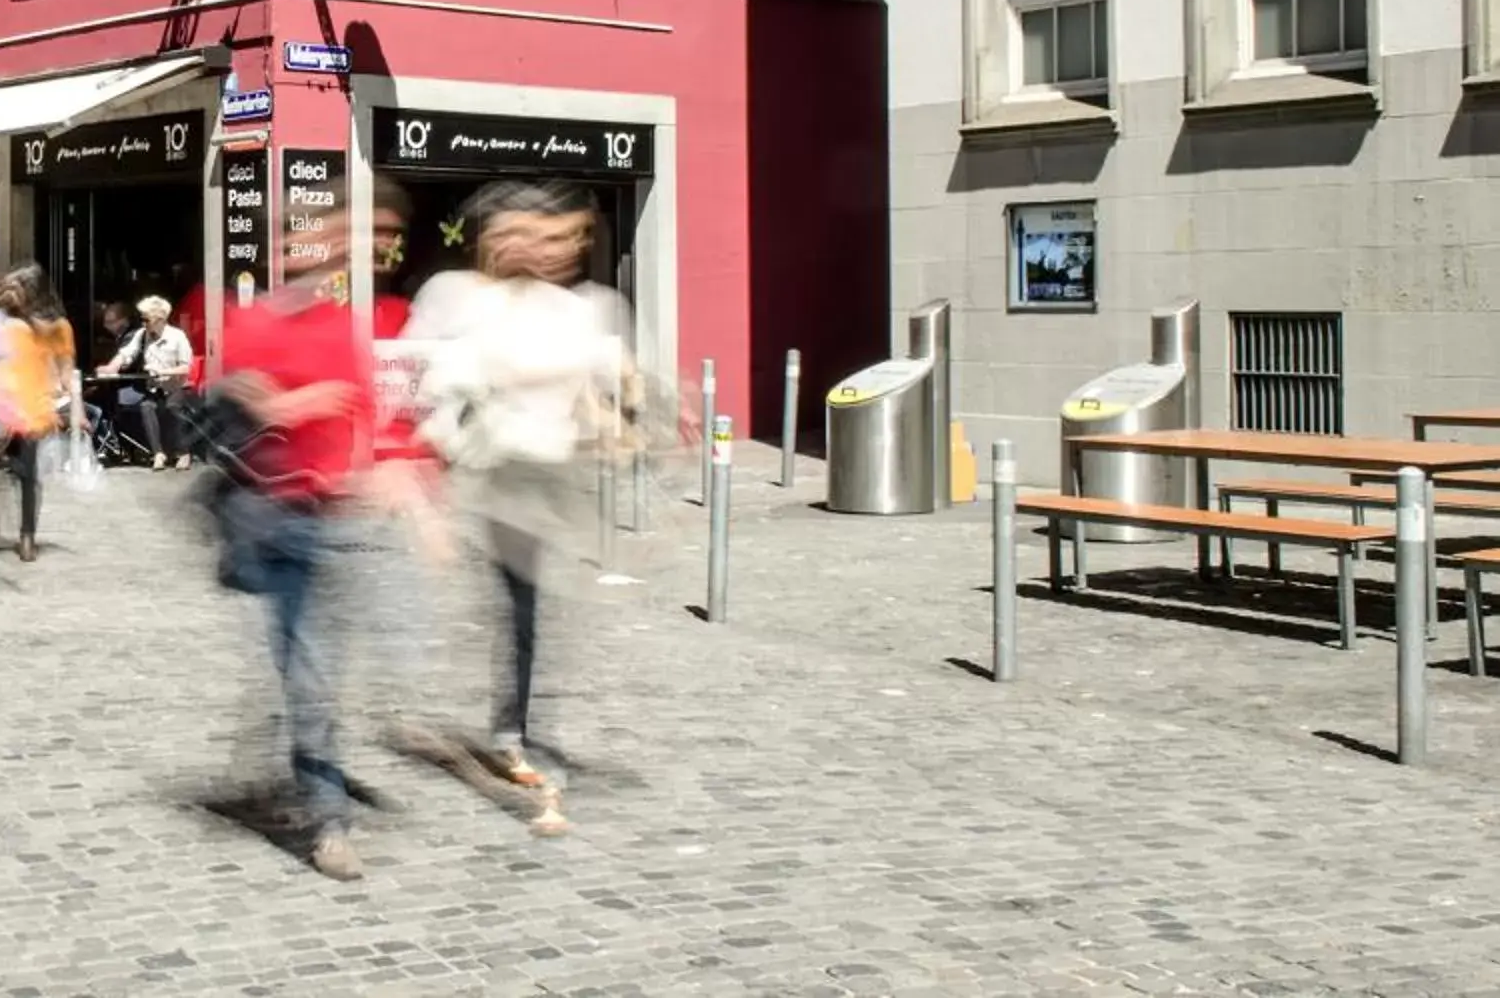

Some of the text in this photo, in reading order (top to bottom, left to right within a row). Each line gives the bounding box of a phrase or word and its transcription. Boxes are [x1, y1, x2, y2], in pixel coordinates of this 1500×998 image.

[228, 162, 255, 182] dieci
[289, 161, 327, 180] dieci
[227, 189, 263, 207] Pasta
[289, 186, 334, 205] Pizza
[228, 215, 252, 233] take
[291, 214, 324, 231] take
[228, 244, 259, 262] away
[291, 242, 331, 261] away
